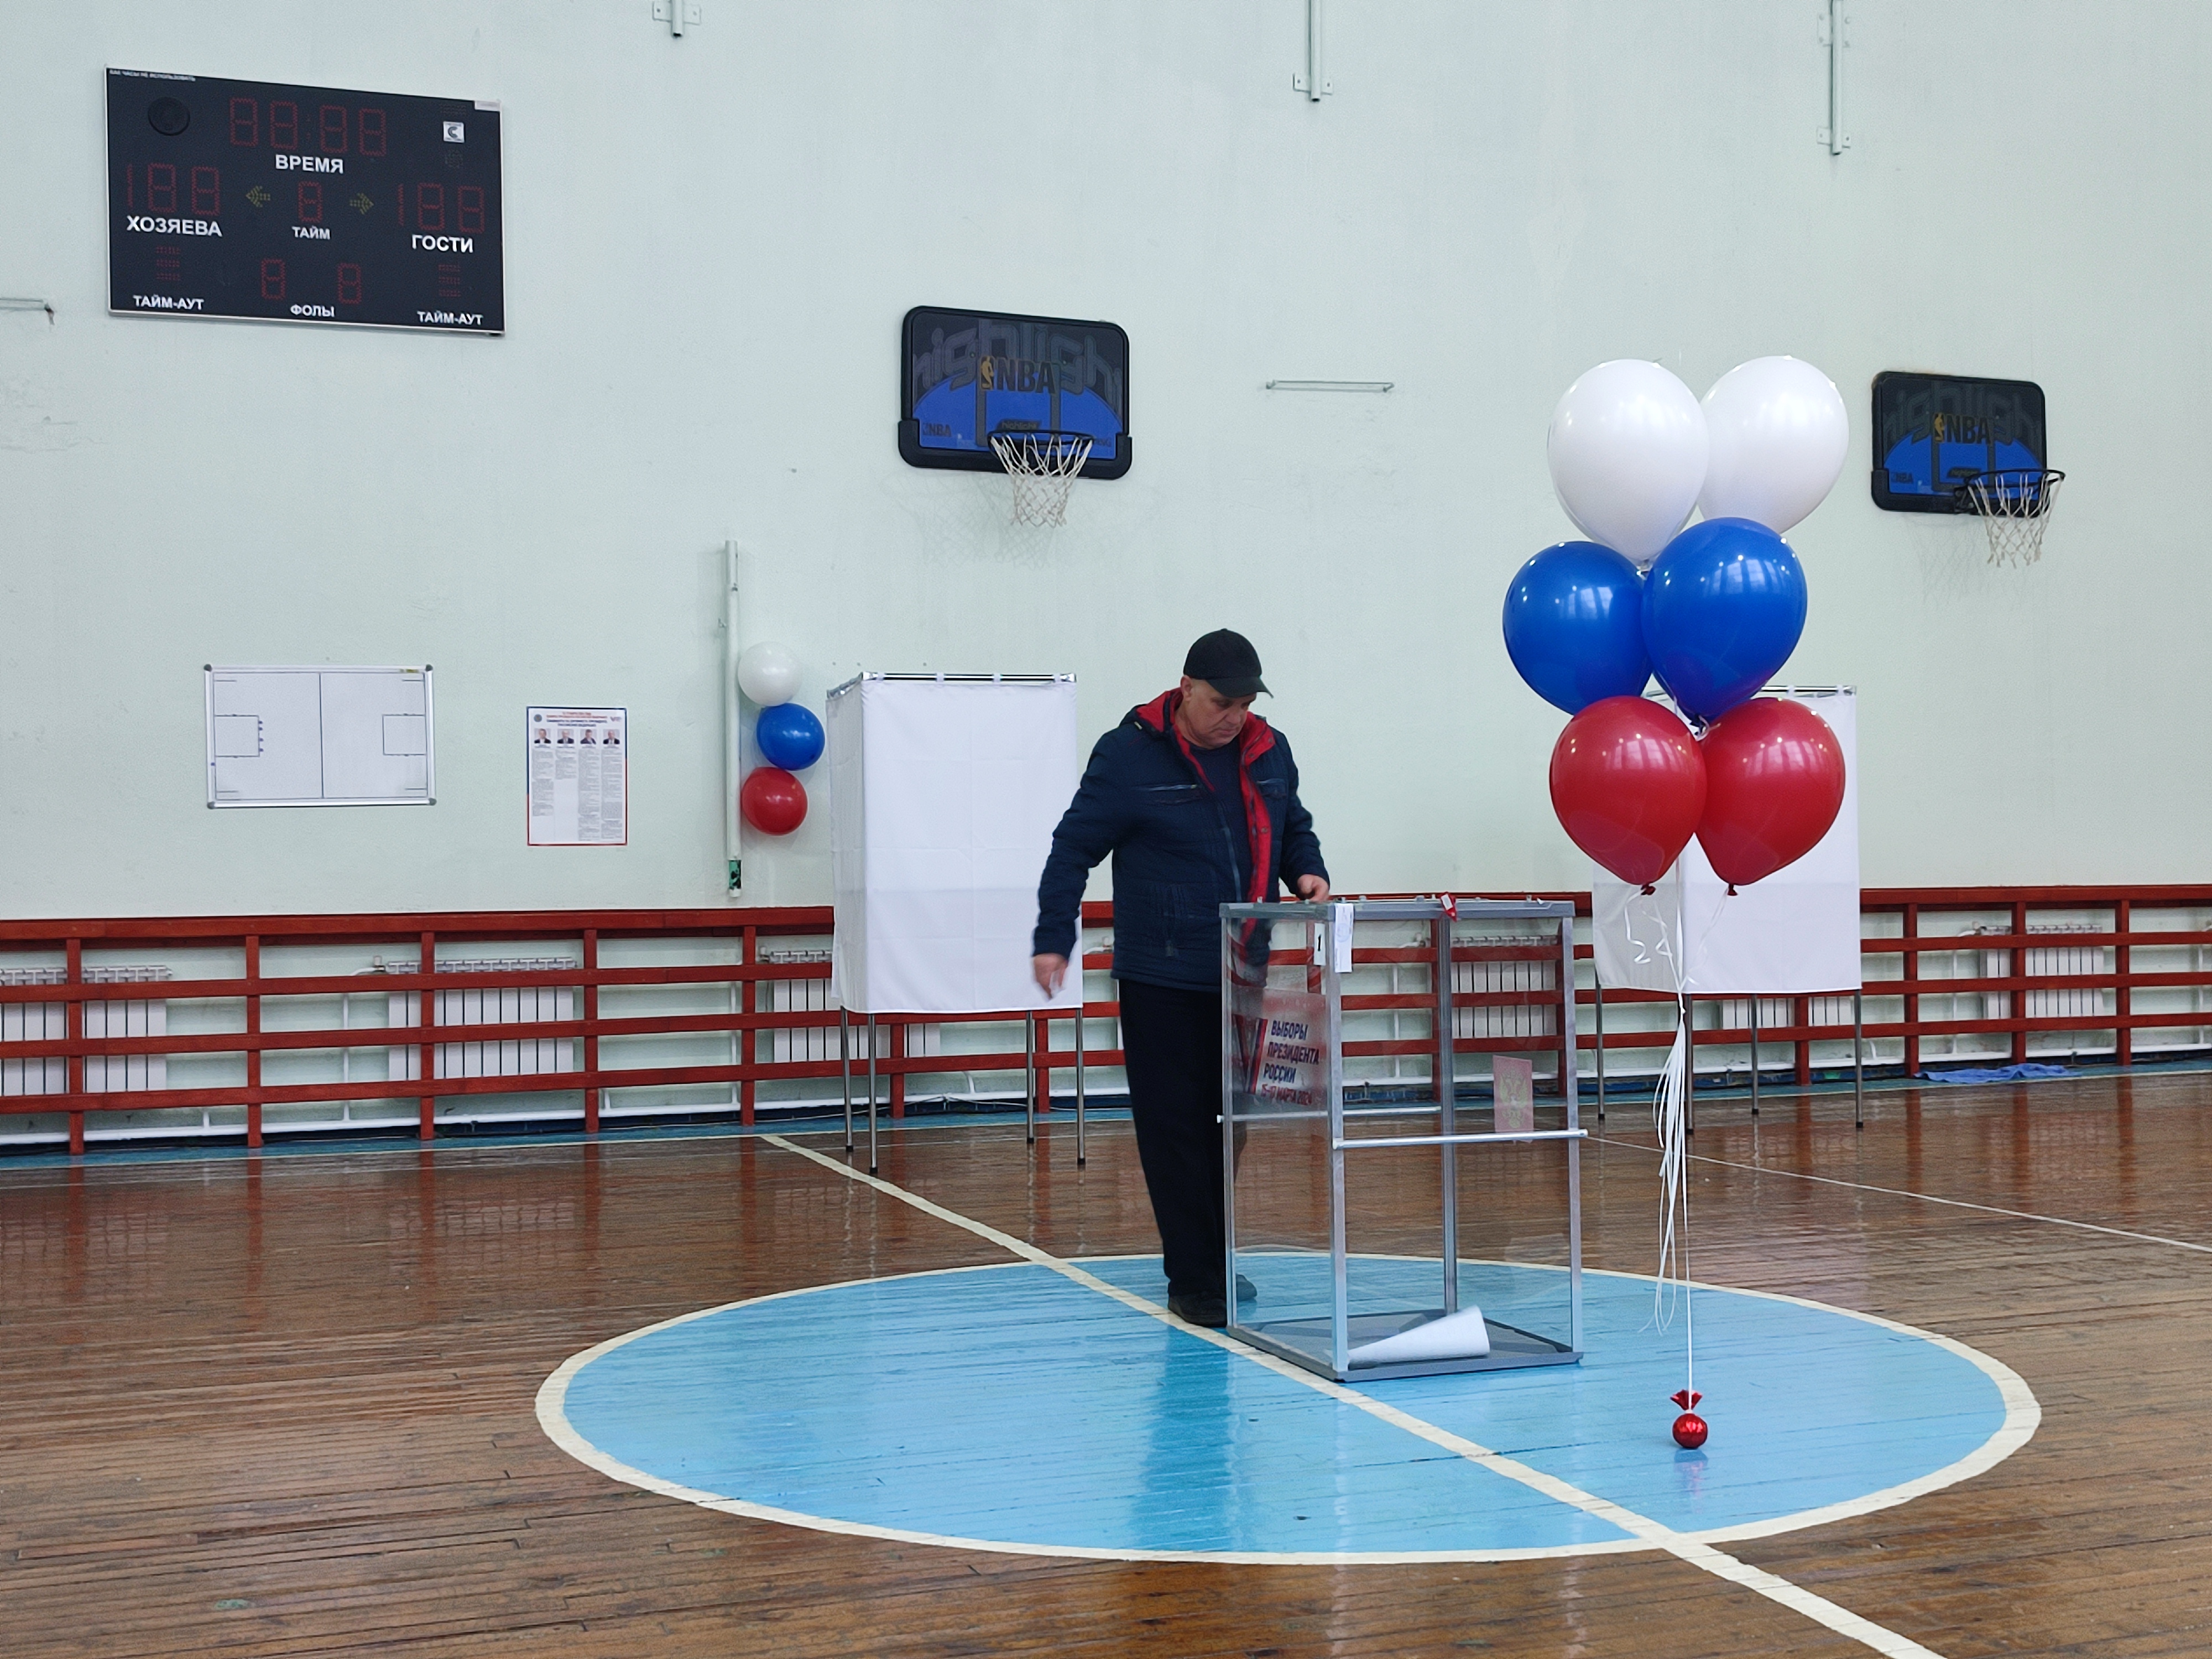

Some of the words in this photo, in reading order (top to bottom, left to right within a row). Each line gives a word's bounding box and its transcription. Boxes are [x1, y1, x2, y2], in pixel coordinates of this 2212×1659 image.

[275, 154, 343, 174] ВРЕМЯ
[127, 215, 222, 237] ХОЗЯЕВА
[291, 226, 331, 240] ТАЙМ
[412, 234, 473, 253] ГОСТИ
[133, 294, 205, 311] ТАЙМ-АУТ
[290, 304, 335, 318] ФОЛЫ
[417, 310, 483, 326] ТАЙМ-АУТ
[995, 358, 1056, 394] NBA
[1945, 415, 1991, 444] NBA
[1271, 1019, 1308, 1041] ВЫБОРЫ
[1267, 1041, 1319, 1065] ПРЕЗИДЕНТА
[1264, 1063, 1297, 1083] РОССИИ
